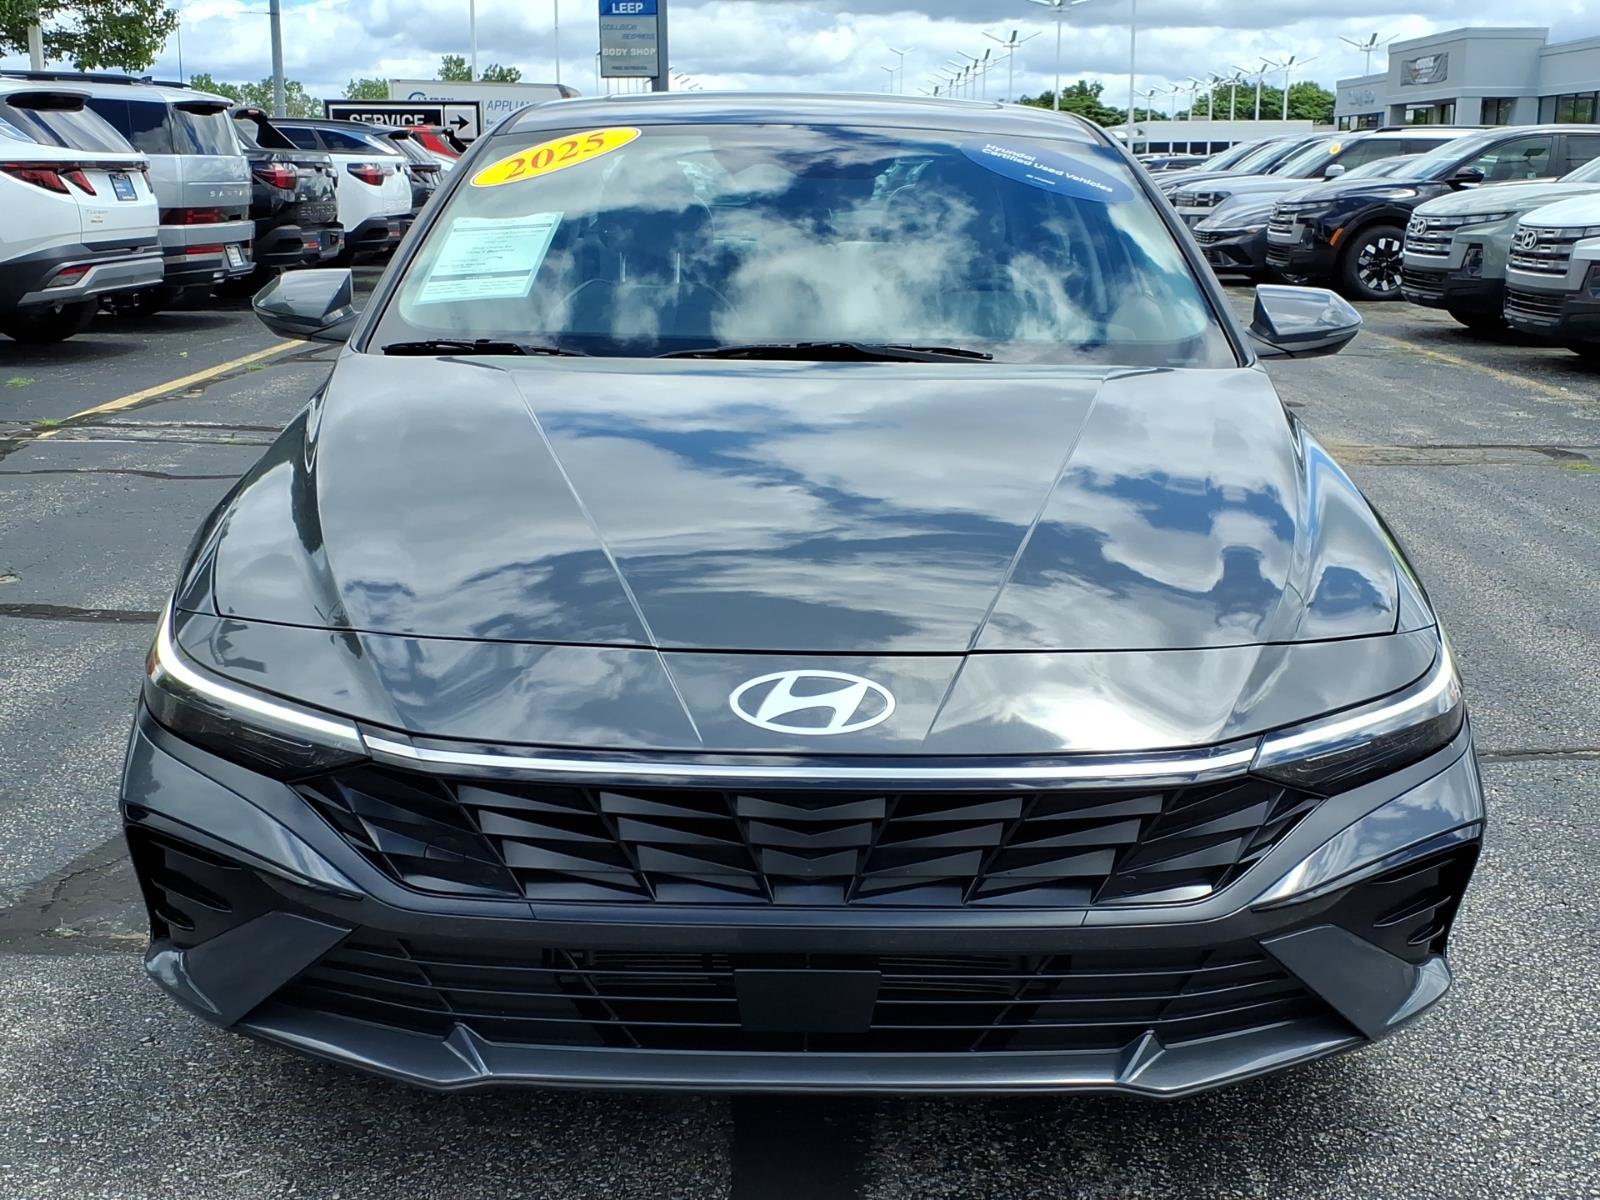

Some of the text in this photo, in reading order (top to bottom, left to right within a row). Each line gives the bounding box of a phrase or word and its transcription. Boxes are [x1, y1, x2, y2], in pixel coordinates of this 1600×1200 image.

[612, 2, 644, 14] LEEP
[602, 48, 656, 56] BODY SHOP
[486, 100, 531, 112] APPLIA
[504, 132, 605, 180] 2025
[985, 143, 1037, 162] Hyundai
[981, 148, 1034, 167] Certified
[1033, 162, 1065, 177] Used
[1064, 172, 1113, 193] Vehicles
